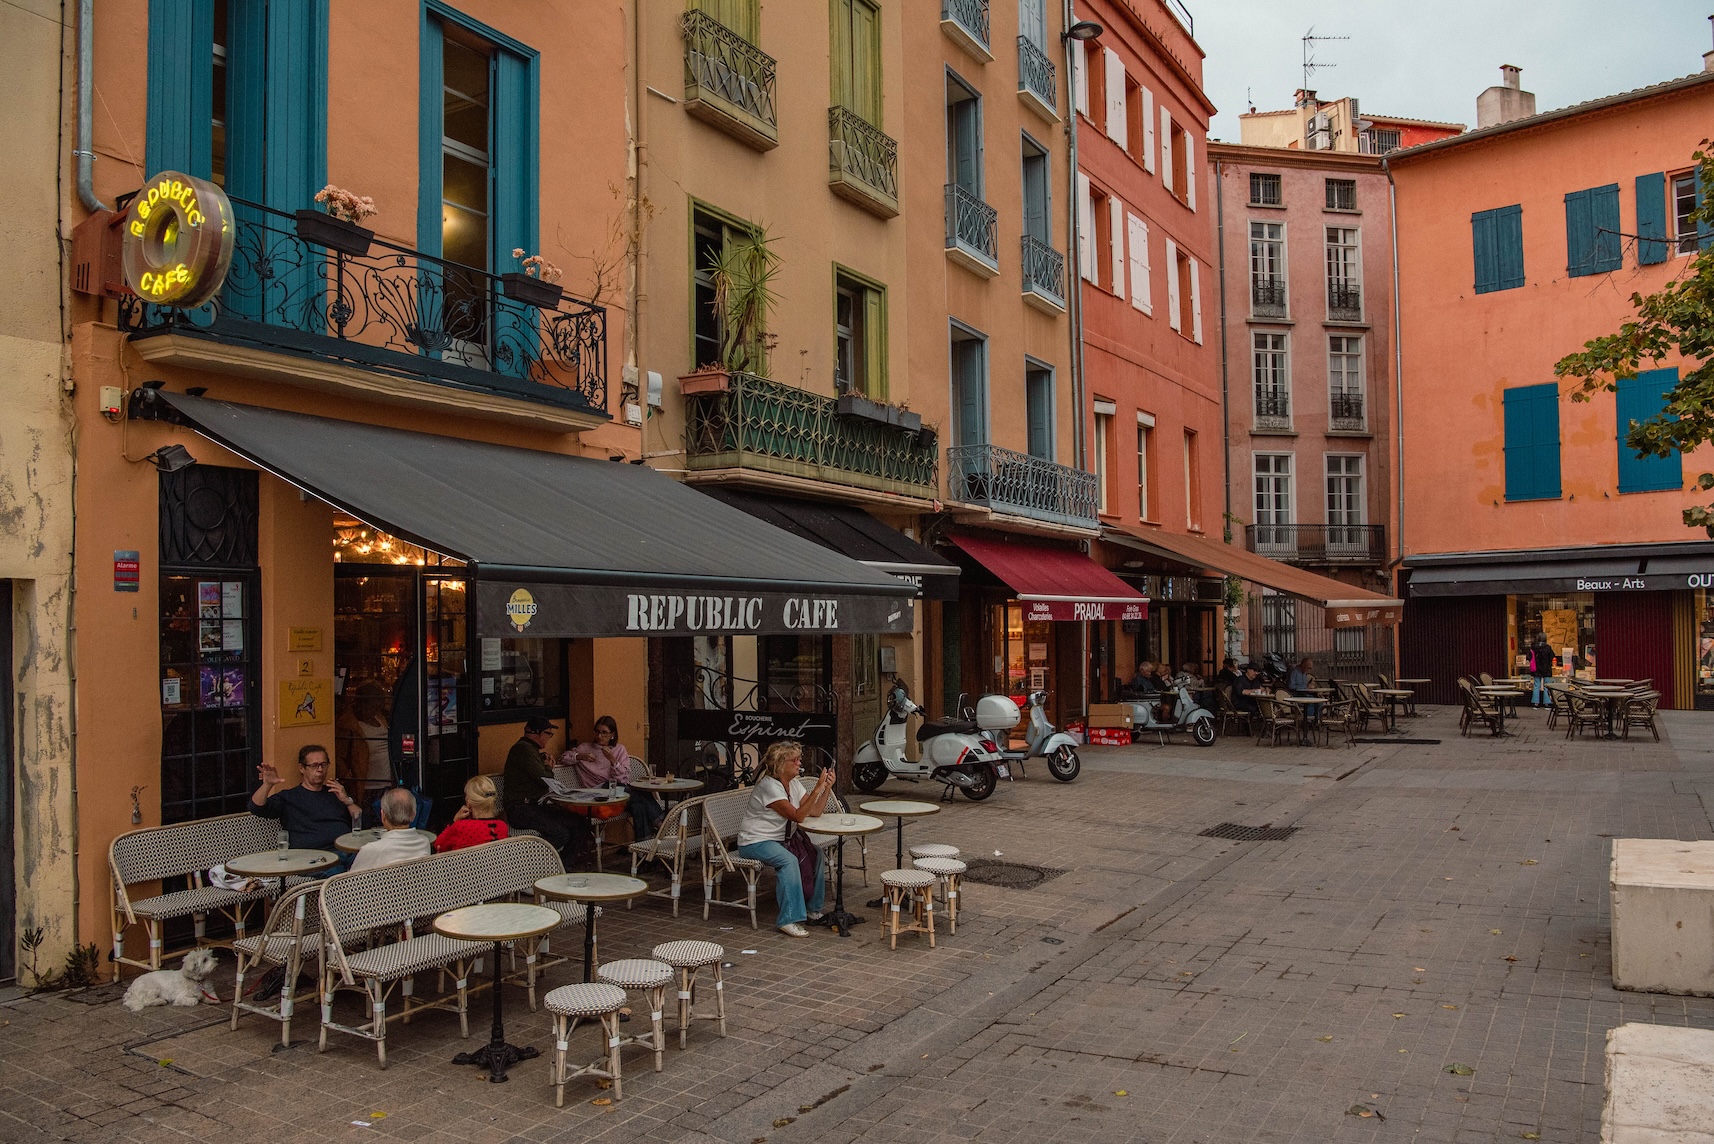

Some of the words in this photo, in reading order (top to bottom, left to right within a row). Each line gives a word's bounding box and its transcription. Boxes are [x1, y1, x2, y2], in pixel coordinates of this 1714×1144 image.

[1577, 579, 1612, 591] Beaux
[1622, 578, 1645, 589] Arts
[506, 603, 537, 614] MILLES
[626, 594, 763, 631] REPUBLIC
[783, 597, 838, 629] CAFE
[1074, 602, 1105, 620] PRADAL
[302, 661, 309, 673] 2
[745, 715, 773, 723] BOUCHERIE
[728, 713, 831, 742] Espinet
